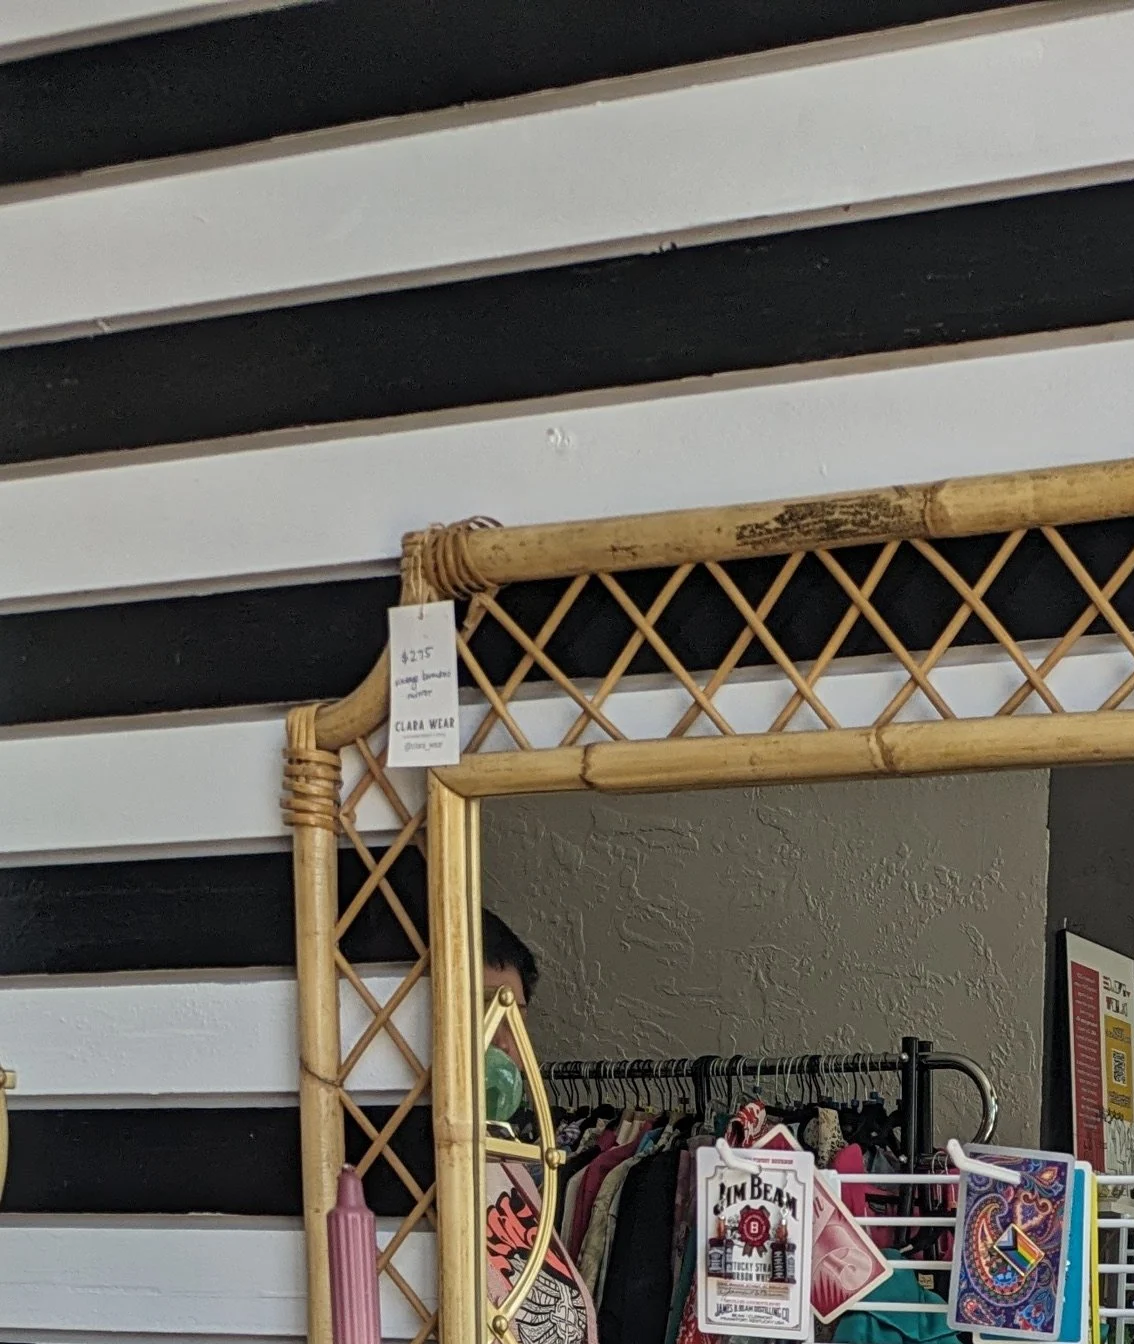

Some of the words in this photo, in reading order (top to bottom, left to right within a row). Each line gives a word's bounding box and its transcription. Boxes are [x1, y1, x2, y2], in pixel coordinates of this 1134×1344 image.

[401, 647, 434, 664] $275
[394, 719, 426, 733] CLARA
[427, 717, 455, 730] WEAR
[750, 1174, 800, 1222] BEAM
